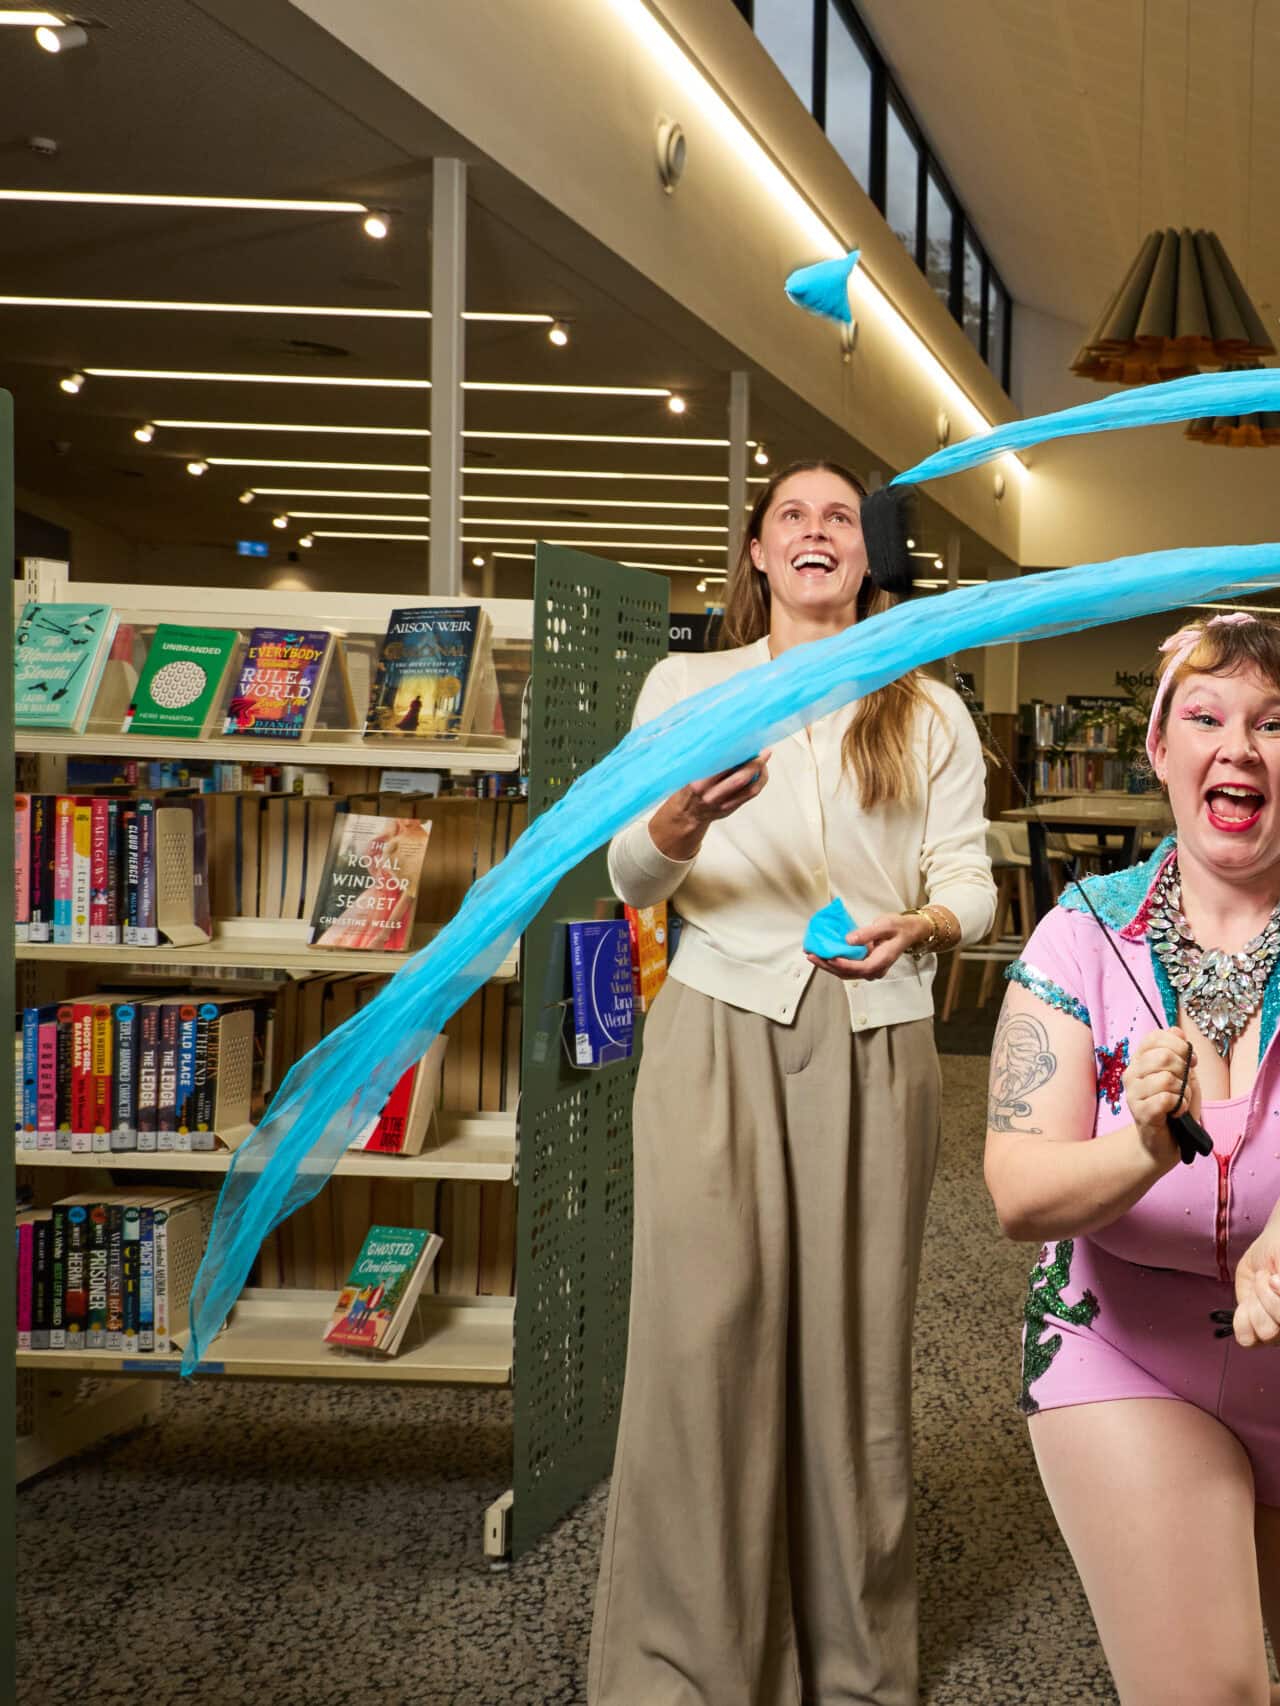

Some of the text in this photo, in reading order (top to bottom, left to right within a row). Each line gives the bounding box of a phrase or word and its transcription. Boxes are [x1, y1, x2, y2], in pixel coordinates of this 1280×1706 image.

[390, 620, 472, 634] ALISON WEIR
[162, 642, 222, 656] UNBRANDED
[248, 646, 323, 662] EVERYBODY
[241, 667, 300, 684] RULE
[240, 683, 311, 700] WORLD
[95, 816, 104, 848] PARIS
[128, 825, 139, 885] CLOUD PIERCER
[347, 854, 401, 871] ROYAL
[332, 872, 409, 891] WINDSOR
[336, 894, 395, 911] SECRET
[319, 916, 402, 929] CHRISTINE WELLS
[74, 1022, 82, 1067] BANANA
[83, 1016, 92, 1049] GHOST
[181, 1021, 193, 1086] WILD PLACE
[141, 1050, 155, 1107] THE LEDGE
[161, 1050, 176, 1107] THE LEDGE
[196, 1059, 207, 1086] END
[111, 1232, 120, 1269] WHITE
[140, 1241, 152, 1273] PACIFIC
[367, 1241, 415, 1256] GHOSTED
[68, 1252, 83, 1293] HERMIT
[89, 1250, 107, 1310] PRISONER
